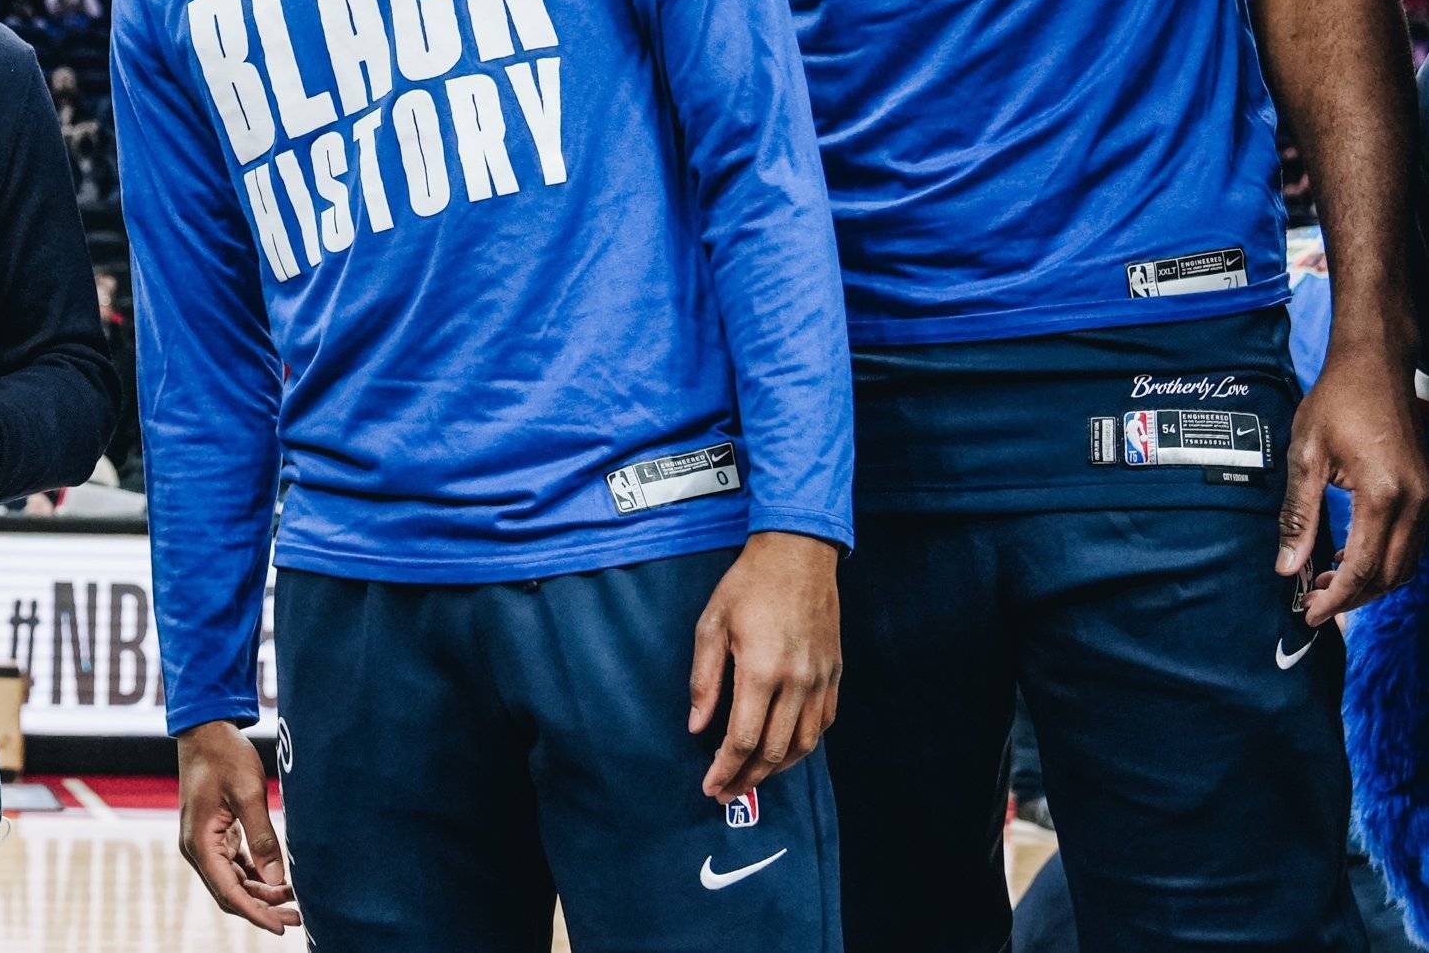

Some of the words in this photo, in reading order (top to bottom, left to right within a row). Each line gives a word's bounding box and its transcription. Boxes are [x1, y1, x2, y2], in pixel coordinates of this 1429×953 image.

[243, 57, 567, 282] HISTORY
[1157, 266, 1177, 277] XXLT
[1180, 255, 1223, 269] ENGINEERED
[1130, 374, 1215, 401] Brotherly
[1211, 375, 1250, 398] Love
[1162, 423, 1176, 434] 54
[1182, 413, 1230, 422] ENGINEERED
[643, 468, 654, 478] L
[716, 470, 730, 486] 0
[731, 805, 745, 825] 75
